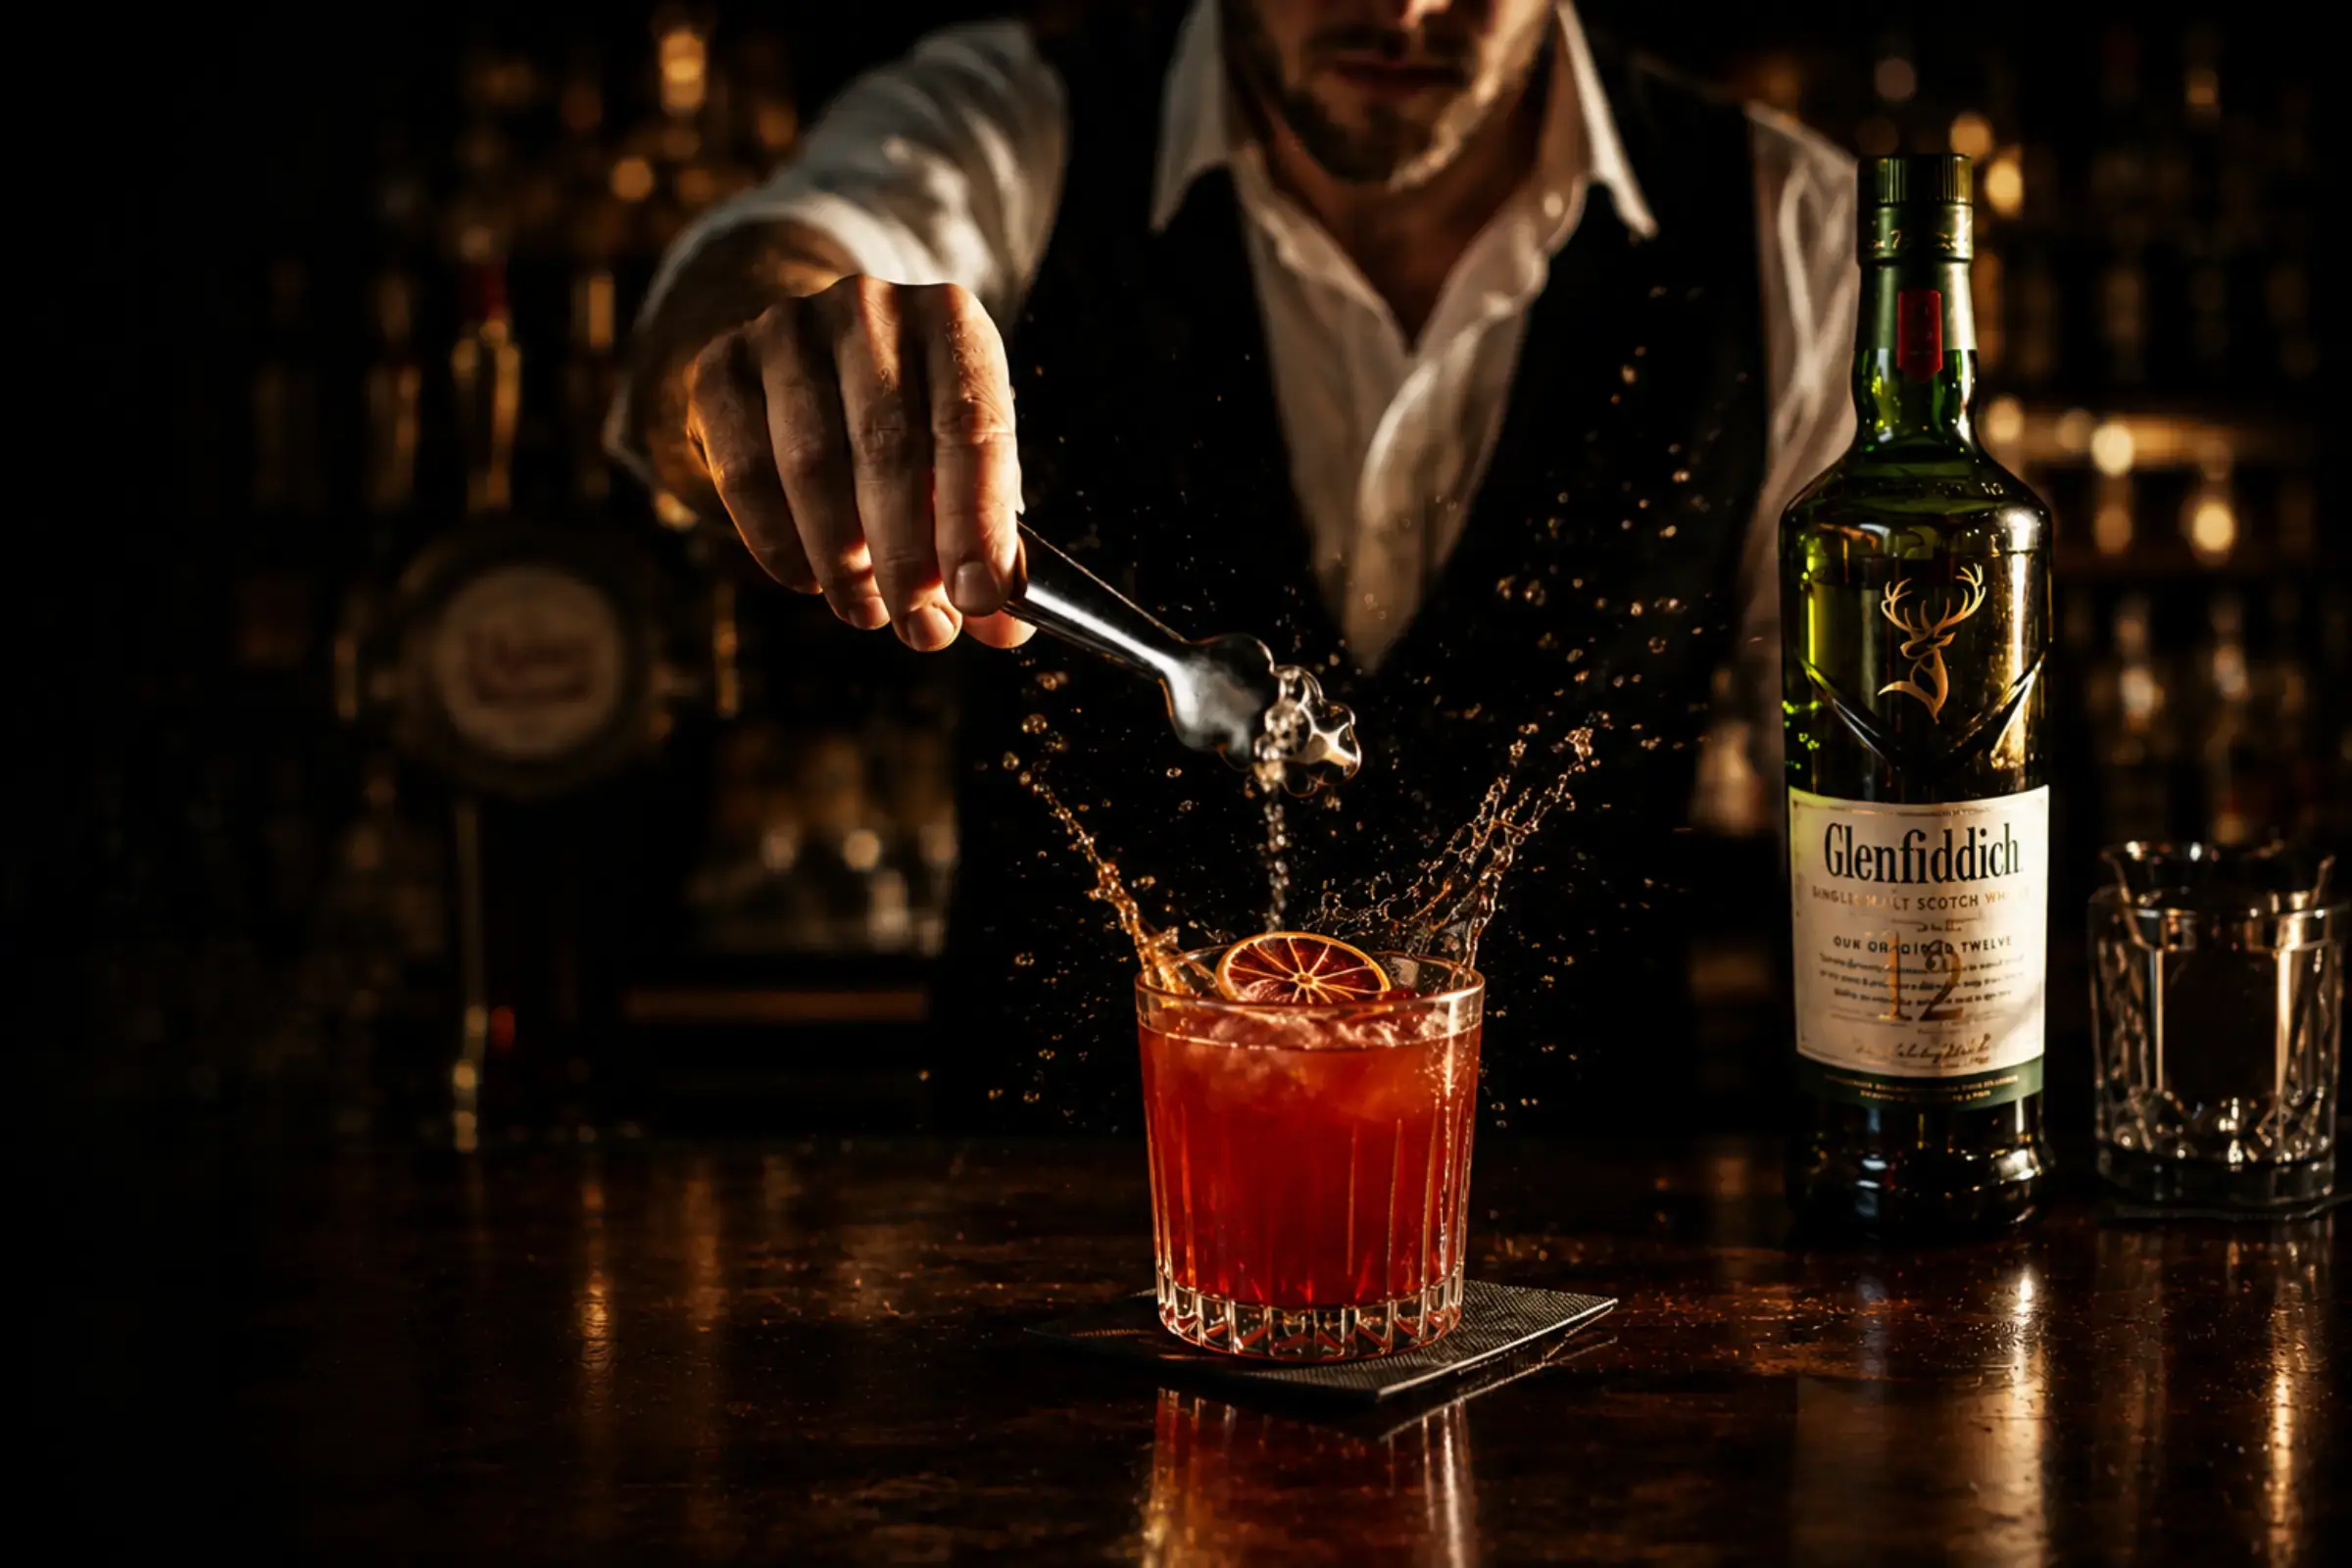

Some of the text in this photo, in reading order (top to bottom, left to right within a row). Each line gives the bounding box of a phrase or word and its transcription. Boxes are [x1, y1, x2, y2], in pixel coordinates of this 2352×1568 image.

[1824, 822, 2021, 884] Glenfiddich
[1917, 894, 1979, 911] SCOTCH
[1961, 936, 2012, 954] TWELVE
[1880, 930, 1965, 1021] 12
